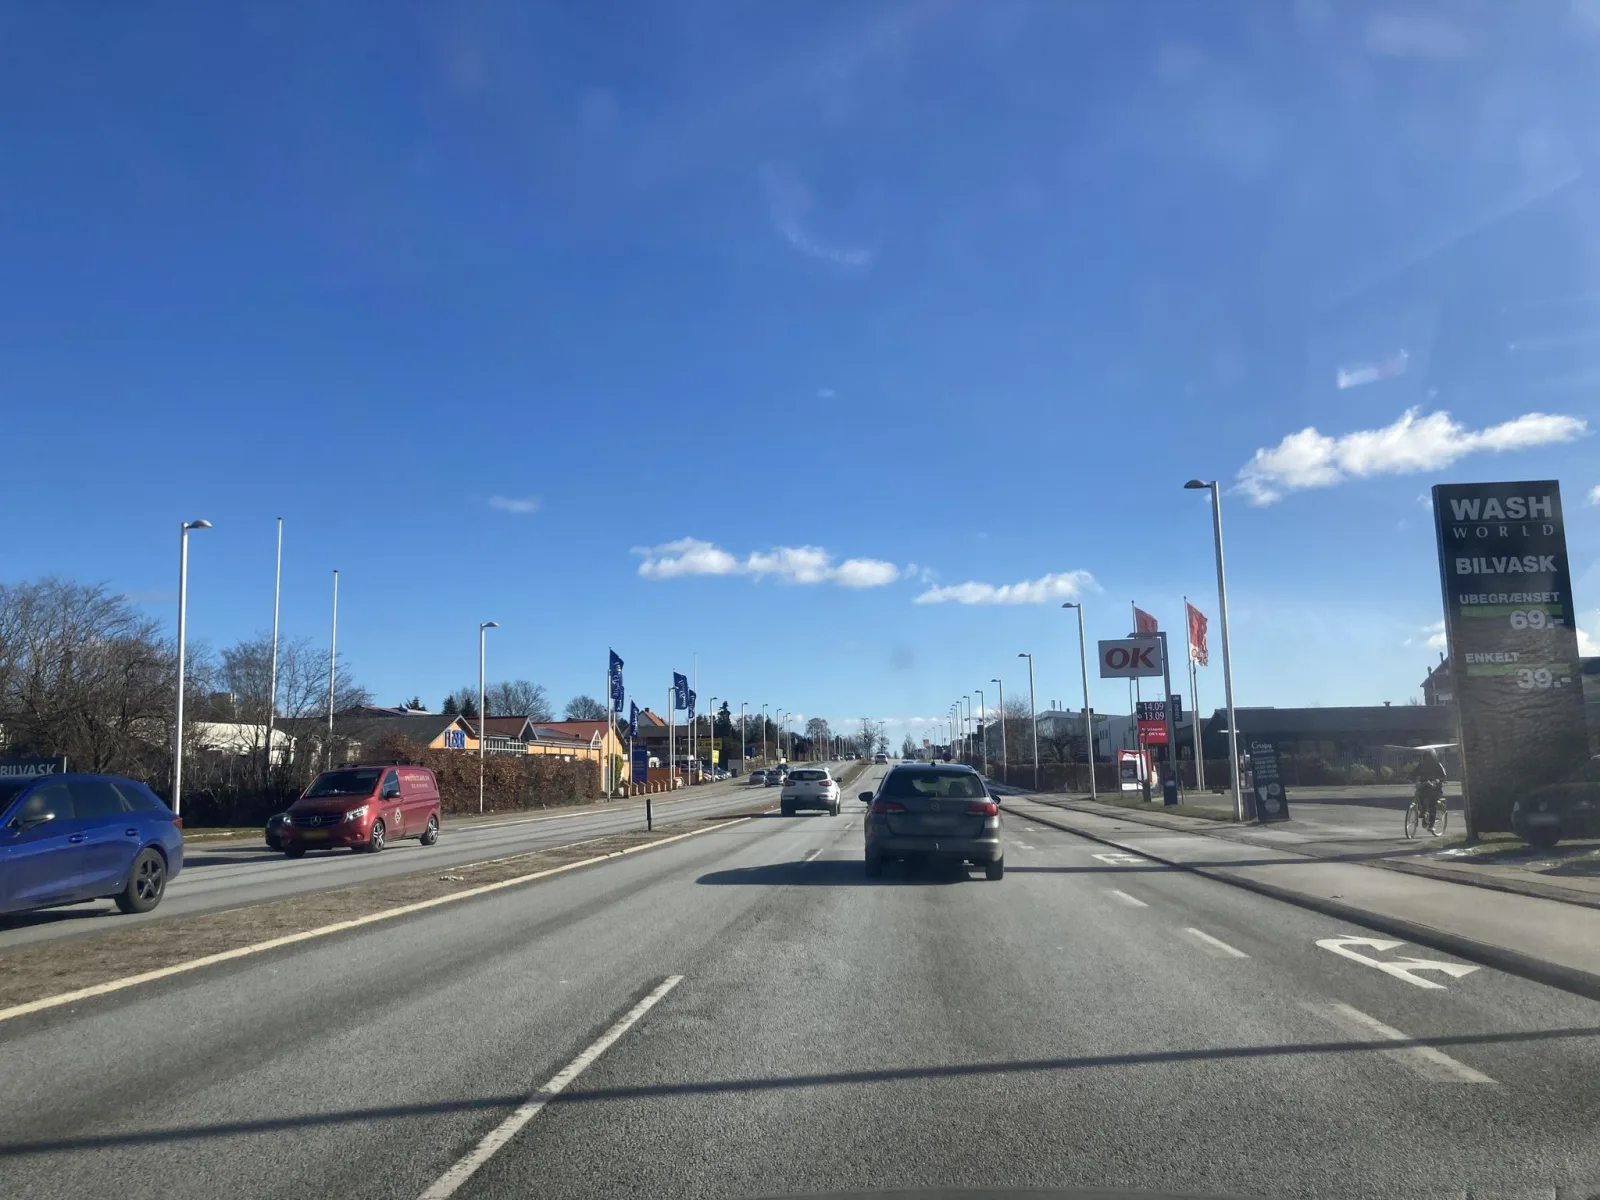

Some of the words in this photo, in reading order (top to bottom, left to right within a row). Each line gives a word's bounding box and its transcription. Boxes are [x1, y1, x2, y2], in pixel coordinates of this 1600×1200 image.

[1450, 496, 1553, 520] WASH
[1453, 524, 1554, 539] WORLD
[1455, 555, 1558, 575] BILVASK
[1459, 591, 1560, 605] UBEGRÆNSET
[1105, 646, 1156, 670] OK
[1465, 652, 1519, 663] ENKELT
[1143, 702, 1163, 710] 14.09
[1144, 711, 1164, 720] 13.09
[0, 763, 56, 776] BILVASK
